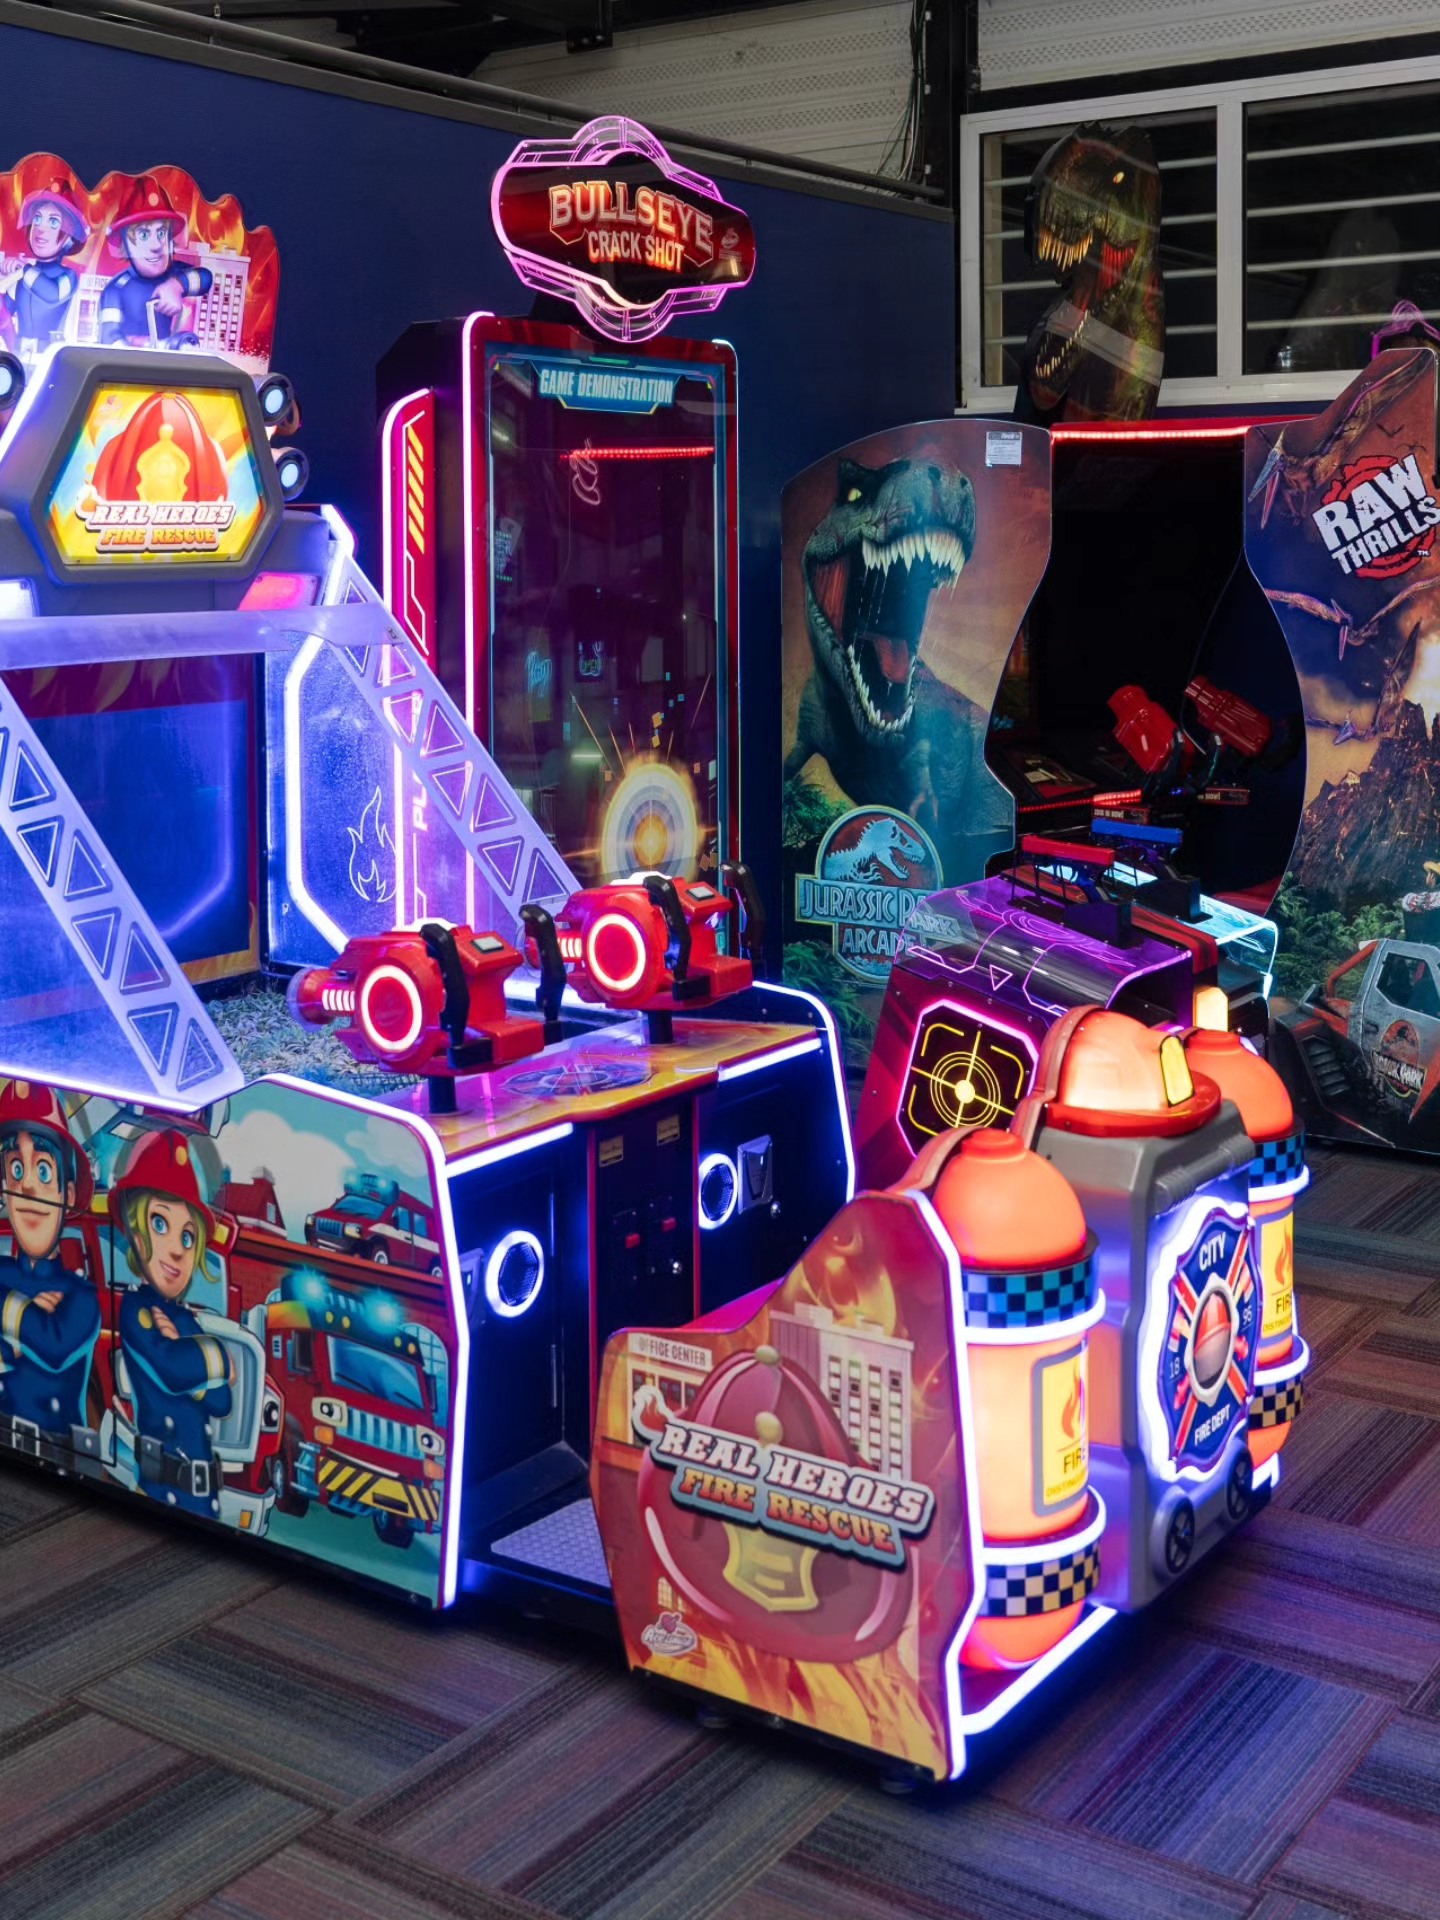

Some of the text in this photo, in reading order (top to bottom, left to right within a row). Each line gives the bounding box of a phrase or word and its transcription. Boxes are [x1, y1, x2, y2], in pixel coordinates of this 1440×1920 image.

[550, 182, 713, 255] BULLSEYE
[588, 229, 684, 272] CRACK SHOT
[540, 369, 673, 403] GAME DEMONSTRATION
[89, 504, 235, 526] REAL HEROES
[1312, 453, 1427, 551] RAW
[100, 528, 217, 545] FIRE RESCUE
[1331, 496, 1440, 575] THRILLS
[801, 881, 894, 922] JURASSIC
[842, 928, 917, 958] ARCADE
[1199, 1231, 1226, 1271] CITY
[1243, 1305, 1252, 1326] 96
[639, 1337, 706, 1367] OFFICE CENTER
[1194, 1403, 1230, 1447] FIRE DEPT
[655, 1422, 926, 1522] REAL HEROES
[679, 1469, 897, 1555] FIRE RESCUE
